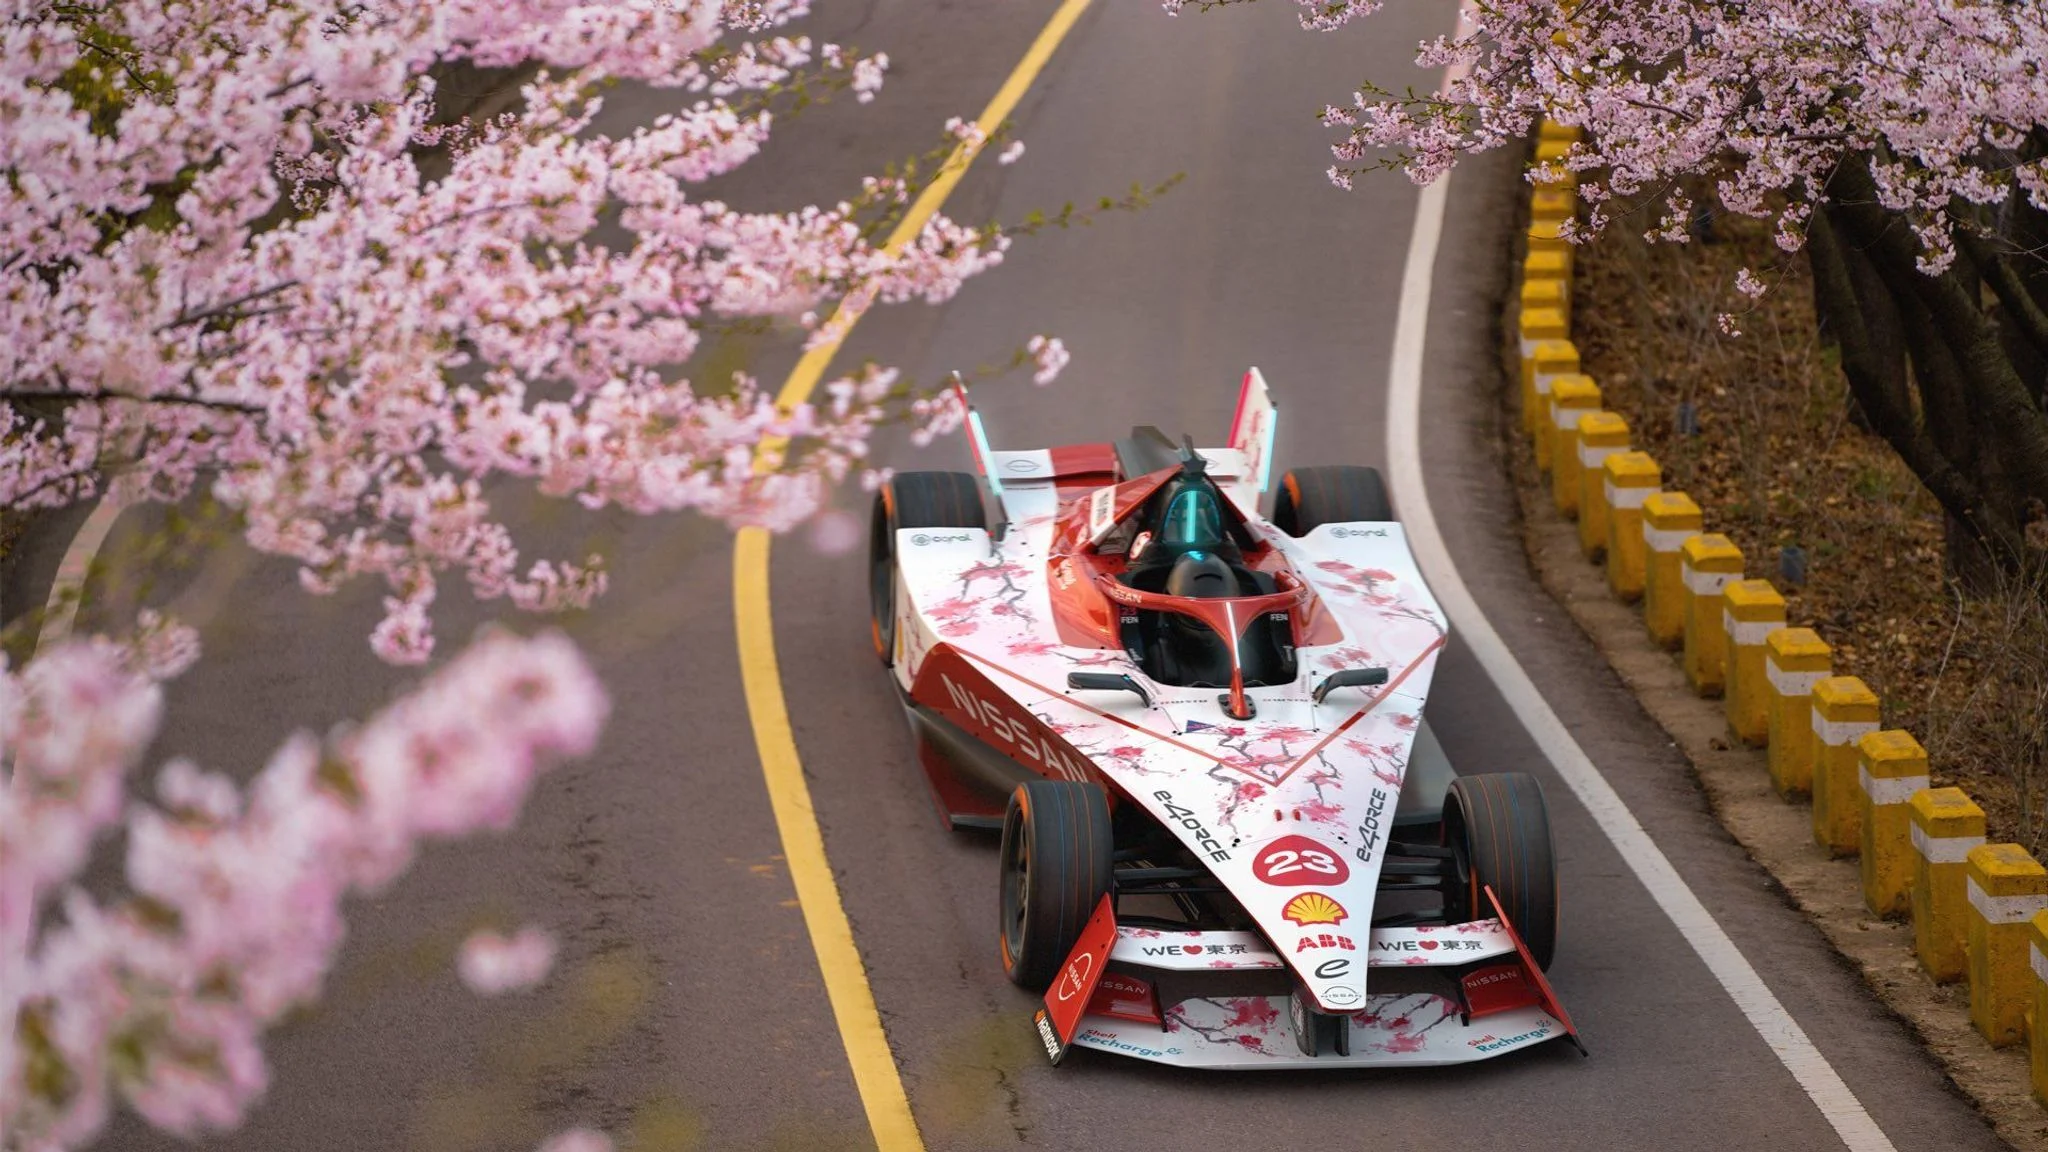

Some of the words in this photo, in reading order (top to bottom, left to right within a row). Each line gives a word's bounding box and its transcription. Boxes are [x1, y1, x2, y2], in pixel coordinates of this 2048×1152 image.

[940, 672, 1089, 783] NISSAN
[1263, 850, 1339, 877] 23
[1143, 945, 1182, 956] WE
[1205, 943, 1249, 956] 東京
[1296, 933, 1356, 954] ABB
[1378, 940, 1418, 951] WE
[1440, 940, 1485, 951] 東京
[1067, 962, 1083, 992] NISSAN
[1098, 980, 1146, 995] ISSAN
[1466, 970, 1519, 989] NISSAN
[1078, 1033, 1163, 1057] Recharge
[1476, 1026, 1551, 1053] Recharge
